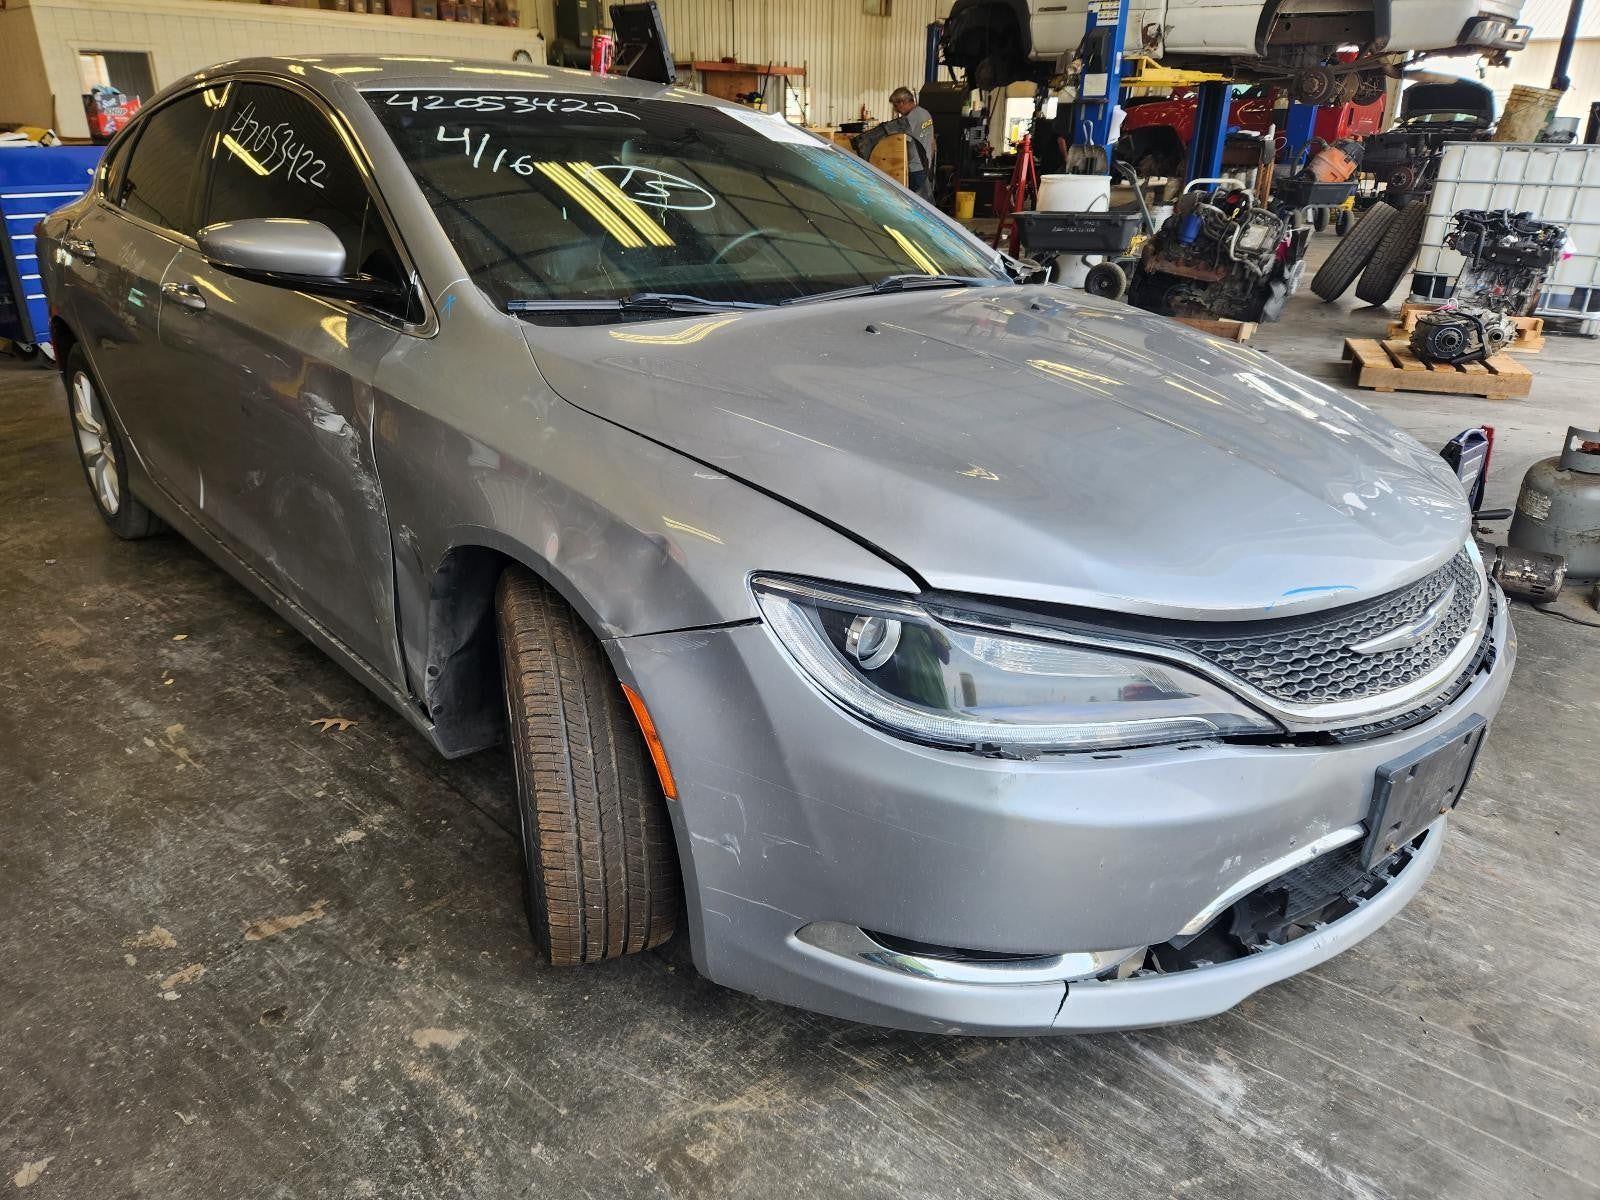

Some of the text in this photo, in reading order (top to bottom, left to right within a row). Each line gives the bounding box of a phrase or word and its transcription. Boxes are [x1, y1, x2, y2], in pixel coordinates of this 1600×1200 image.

[386, 94, 640, 120] 42053422
[228, 101, 325, 189] 42053422
[437, 125, 534, 176] 4/16
